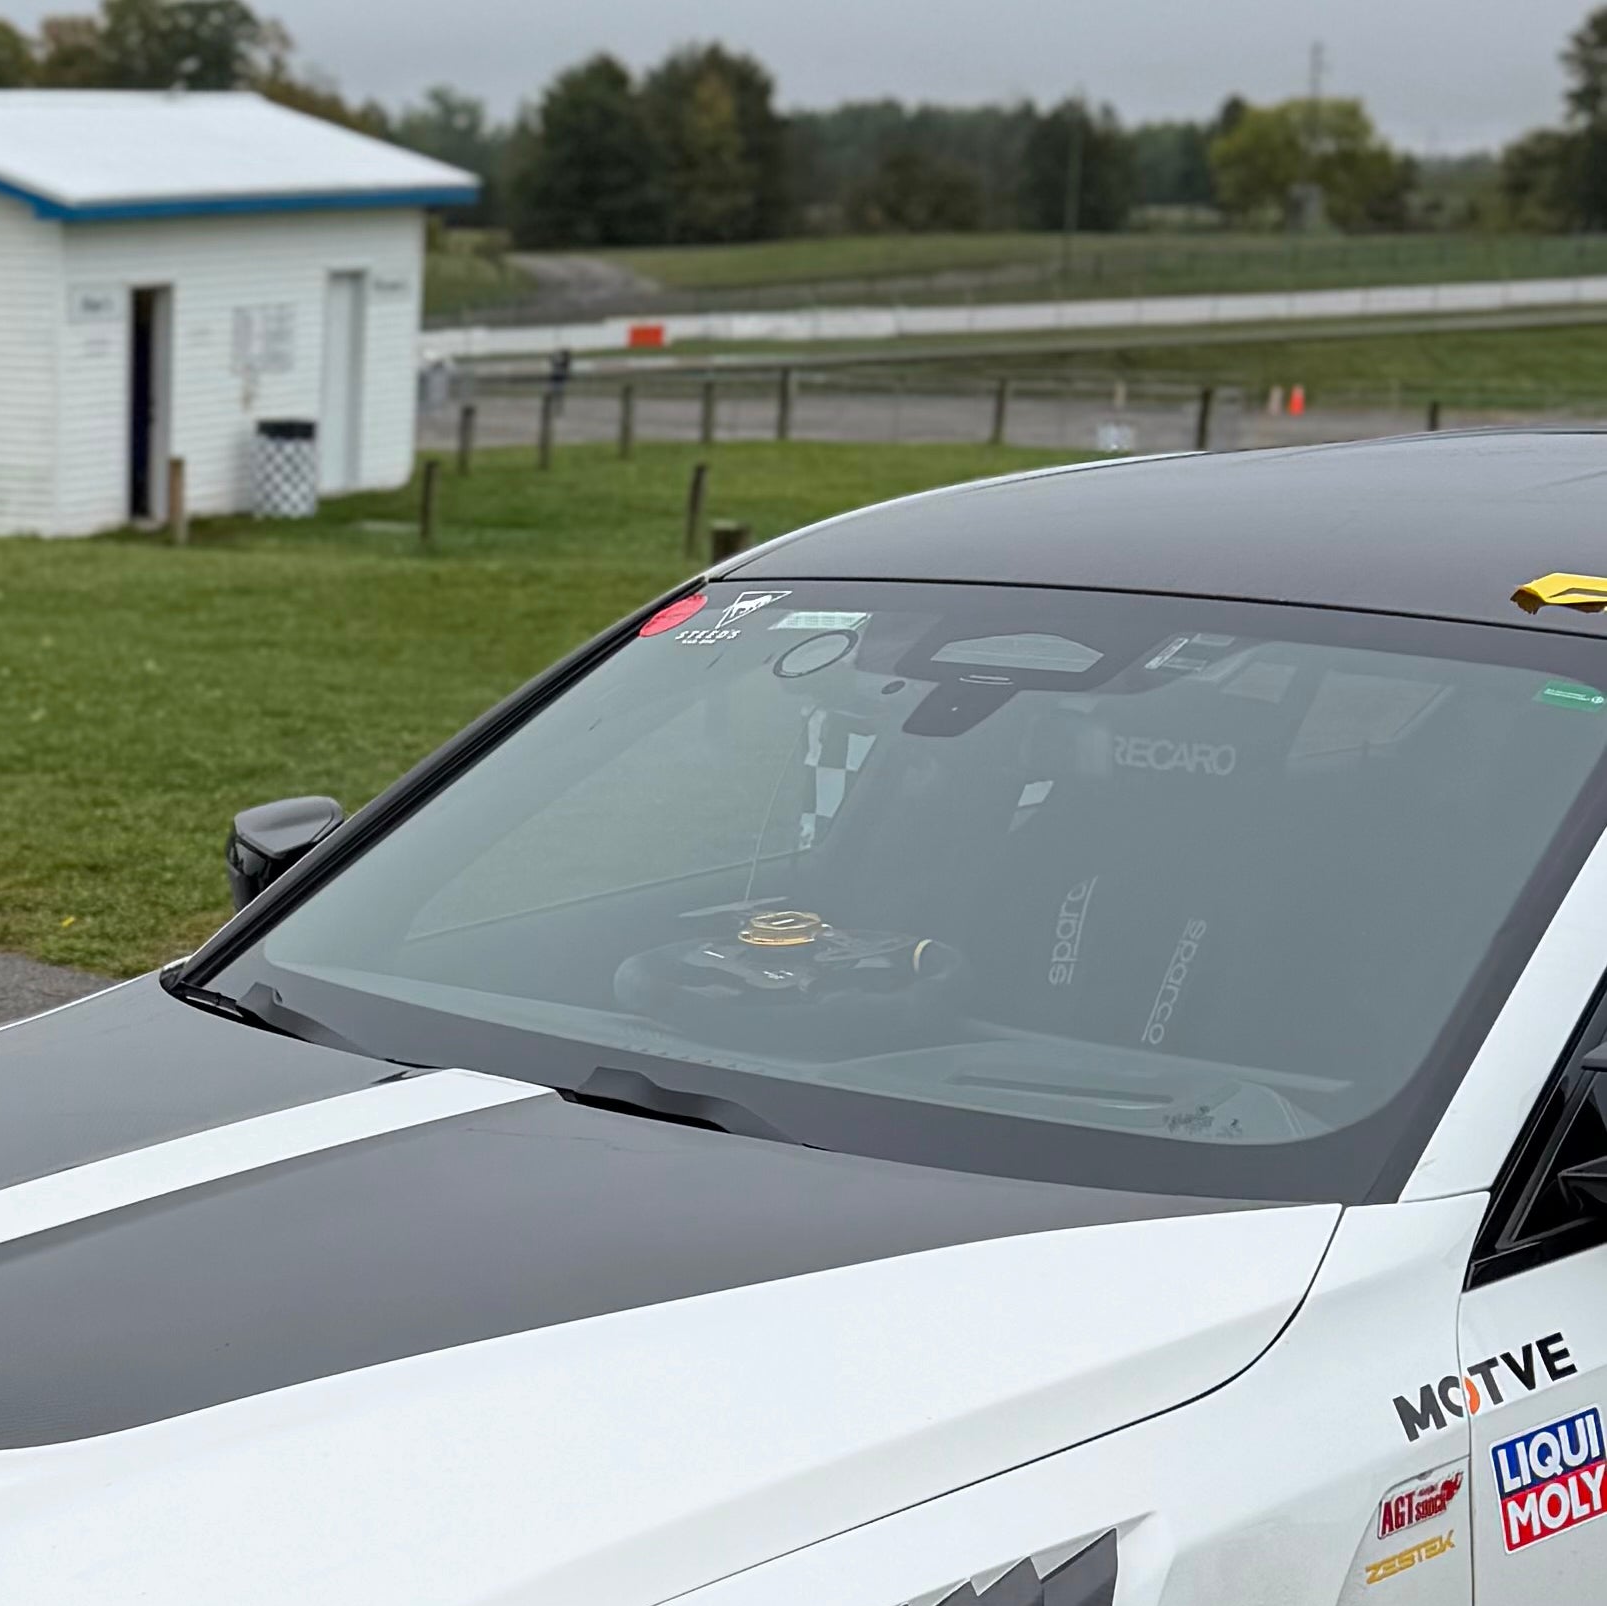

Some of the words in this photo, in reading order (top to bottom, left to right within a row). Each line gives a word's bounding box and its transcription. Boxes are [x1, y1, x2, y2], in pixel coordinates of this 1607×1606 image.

[1114, 735, 1236, 776] RECARO
[1048, 878, 1096, 985] sparc
[1143, 919, 1207, 1045] sparco
[1392, 1332, 1578, 1442] MOTVE
[1497, 1414, 1600, 1493] LIQUI
[1381, 1491, 1416, 1536] AGT
[1507, 1464, 1606, 1544] MOLY
